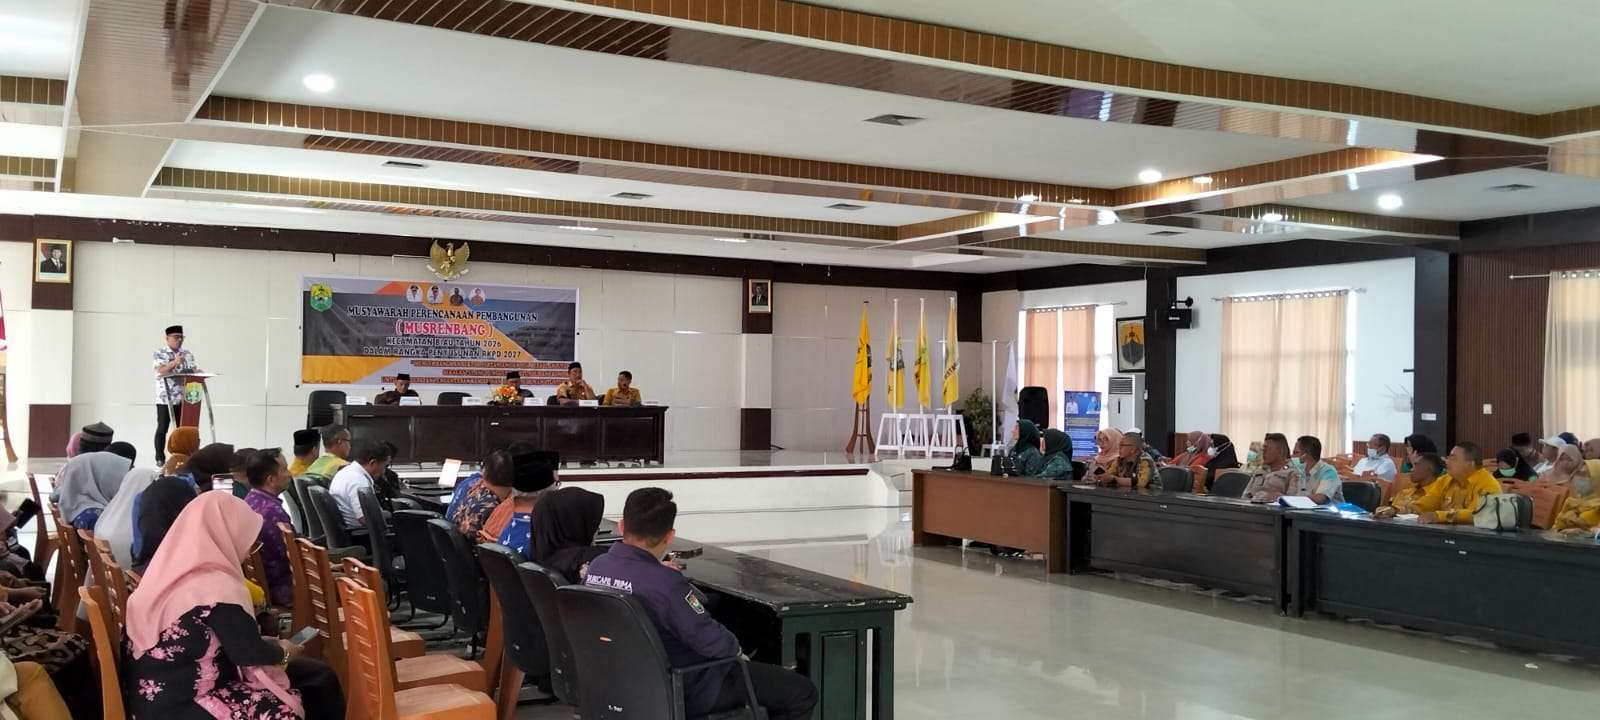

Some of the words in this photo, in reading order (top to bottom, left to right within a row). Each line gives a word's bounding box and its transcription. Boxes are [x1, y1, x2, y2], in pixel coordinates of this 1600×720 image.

[347, 306, 409, 318] MUSYAWARAH
[410, 307, 474, 320] PERENCANAAN
[475, 311, 538, 322] PEMBANGUNAN
[404, 321, 485, 336] MUSRENBANG
[386, 336, 433, 347] KECAMATAN
[435, 338, 453, 347] BIAU
[456, 339, 481, 347] TAHUN
[484, 340, 502, 348] 2026
[363, 346, 393, 356] DALAM
[394, 347, 428, 357] RANGKA
[429, 349, 480, 358] PENYUSUNAN
[482, 350, 502, 359] RKPD
[504, 351, 522, 359] 2027
[613, 579, 632, 591] PRIMA
